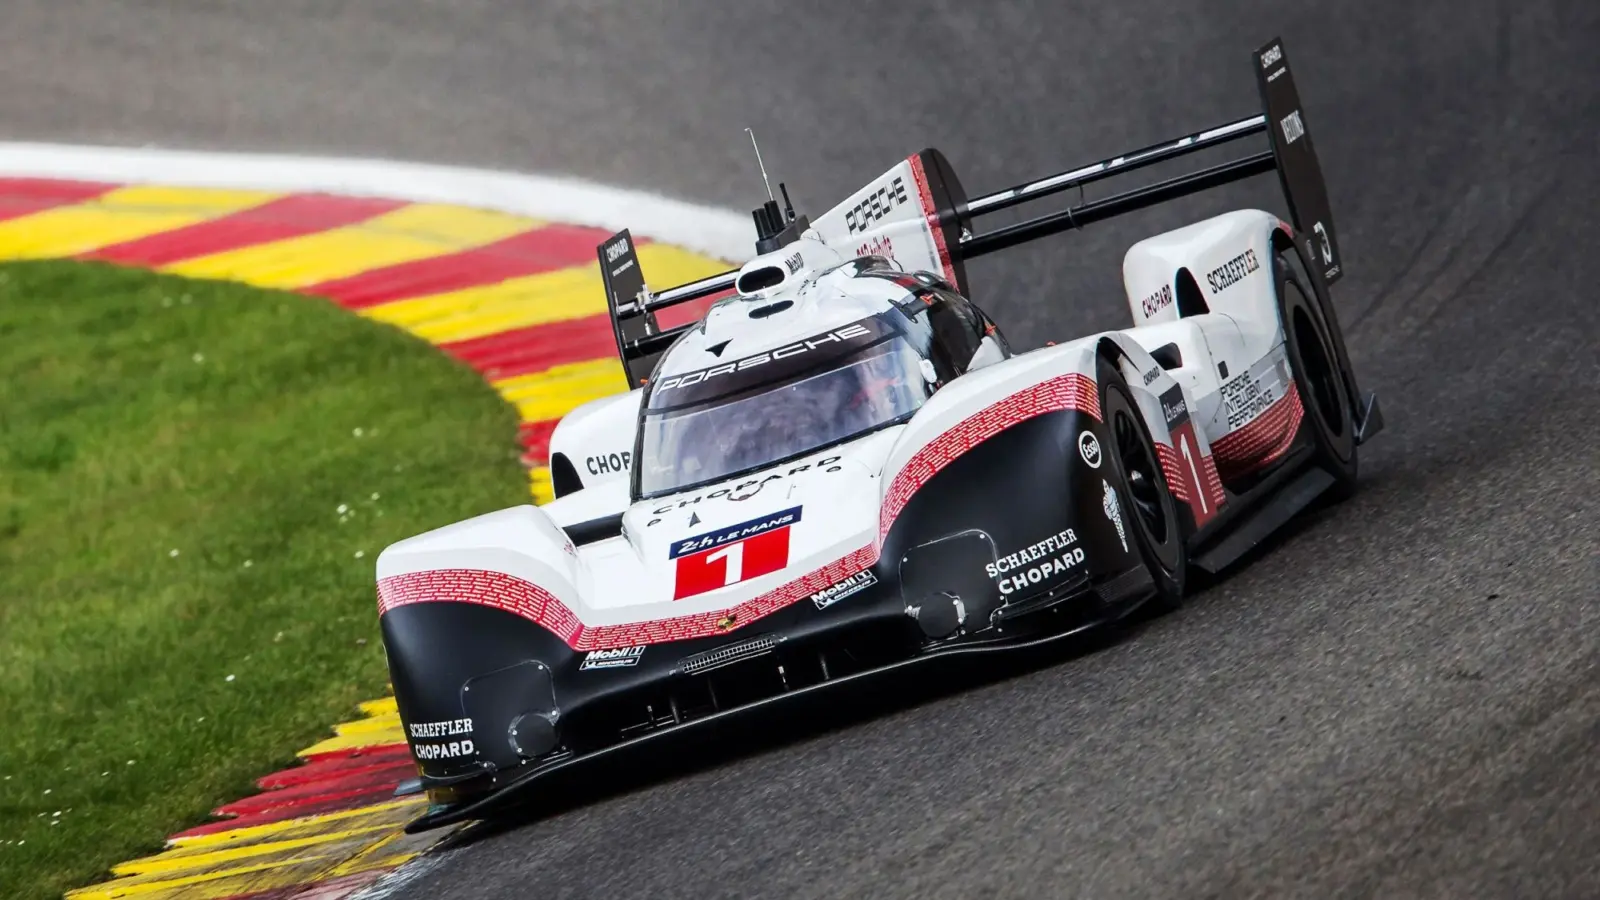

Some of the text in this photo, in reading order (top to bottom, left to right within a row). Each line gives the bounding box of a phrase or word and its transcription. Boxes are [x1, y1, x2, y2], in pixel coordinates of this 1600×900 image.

[845, 176, 907, 235] PORSCHE
[1207, 248, 1260, 294] SCHAEFFLER
[1142, 283, 1172, 319] CHOPARD
[656, 324, 871, 395] PORSCHE
[1220, 370, 1251, 400] PORSCHE
[1224, 379, 1260, 415] INTELLIGENT
[1228, 388, 1274, 431] PERFORMANCE
[652, 455, 842, 515] CHOPARD
[1180, 432, 1208, 514] 1
[717, 529, 740, 543] LE
[741, 513, 794, 536] MANS
[705, 541, 744, 586] 1
[985, 527, 1078, 578] SCHAEFFLER
[999, 547, 1086, 595] CHOPARD
[810, 576, 857, 604] Mobil
[585, 647, 631, 661] Mobil
[409, 717, 474, 738] SCHAEFFLER
[415, 739, 475, 759] CHOPARD
